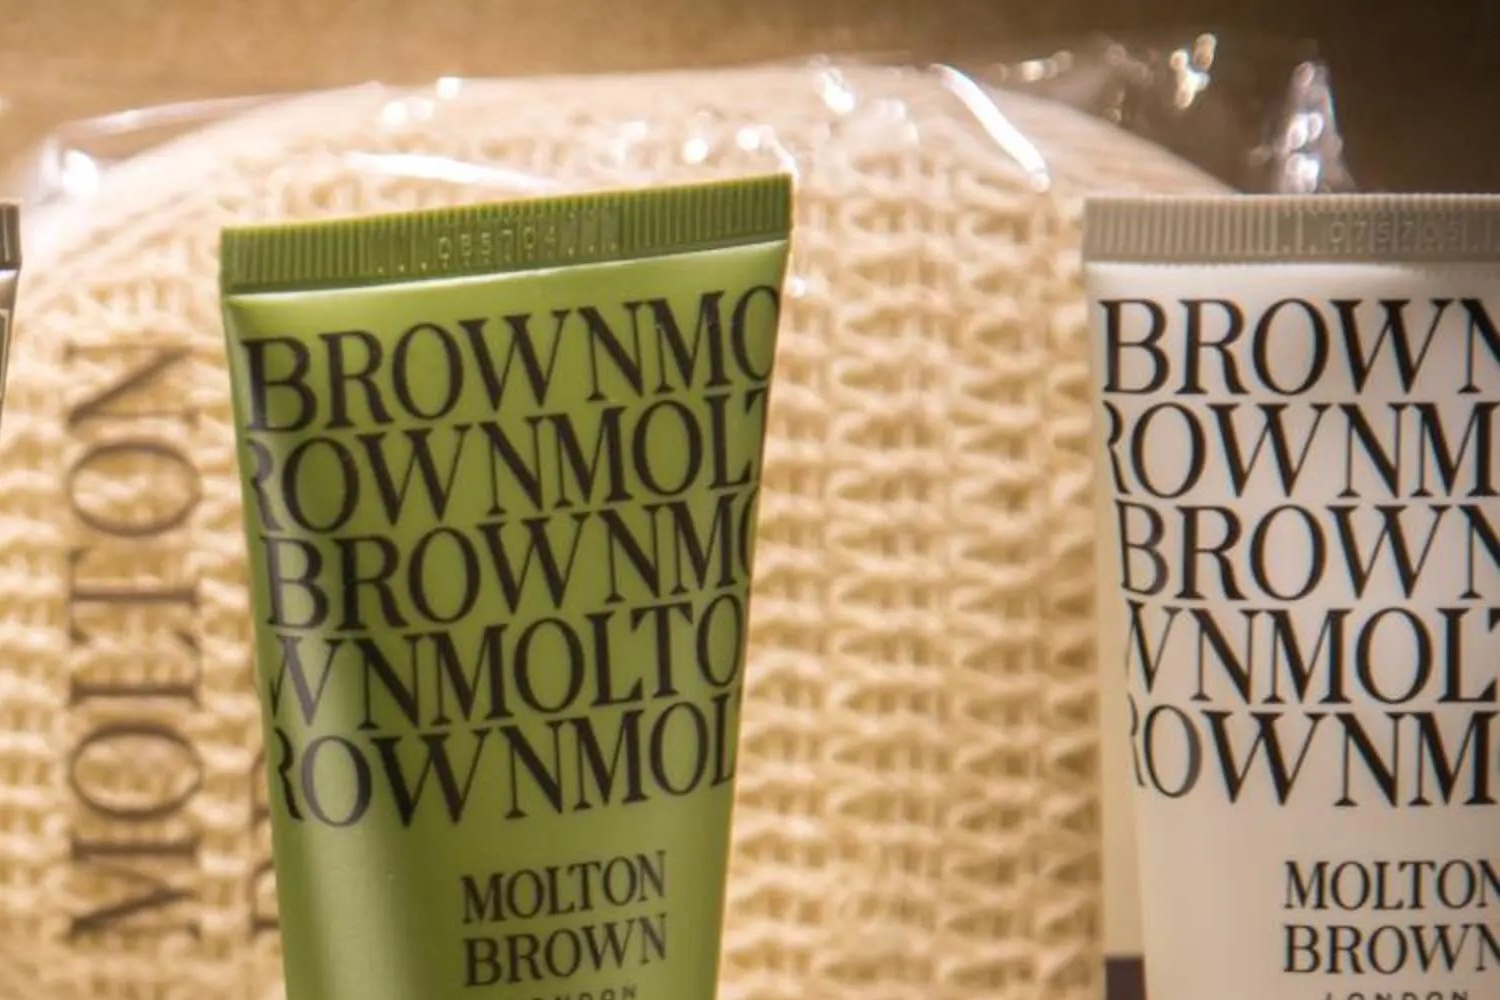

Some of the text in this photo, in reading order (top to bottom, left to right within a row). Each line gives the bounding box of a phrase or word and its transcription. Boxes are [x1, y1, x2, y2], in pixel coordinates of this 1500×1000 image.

[241, 285, 781, 434] BROWNMO
[260, 488, 758, 632] BROWNM
[66, 342, 202, 943] MOLTON
[460, 850, 667, 925] MOLTON
[462, 913, 668, 988] BROWN
